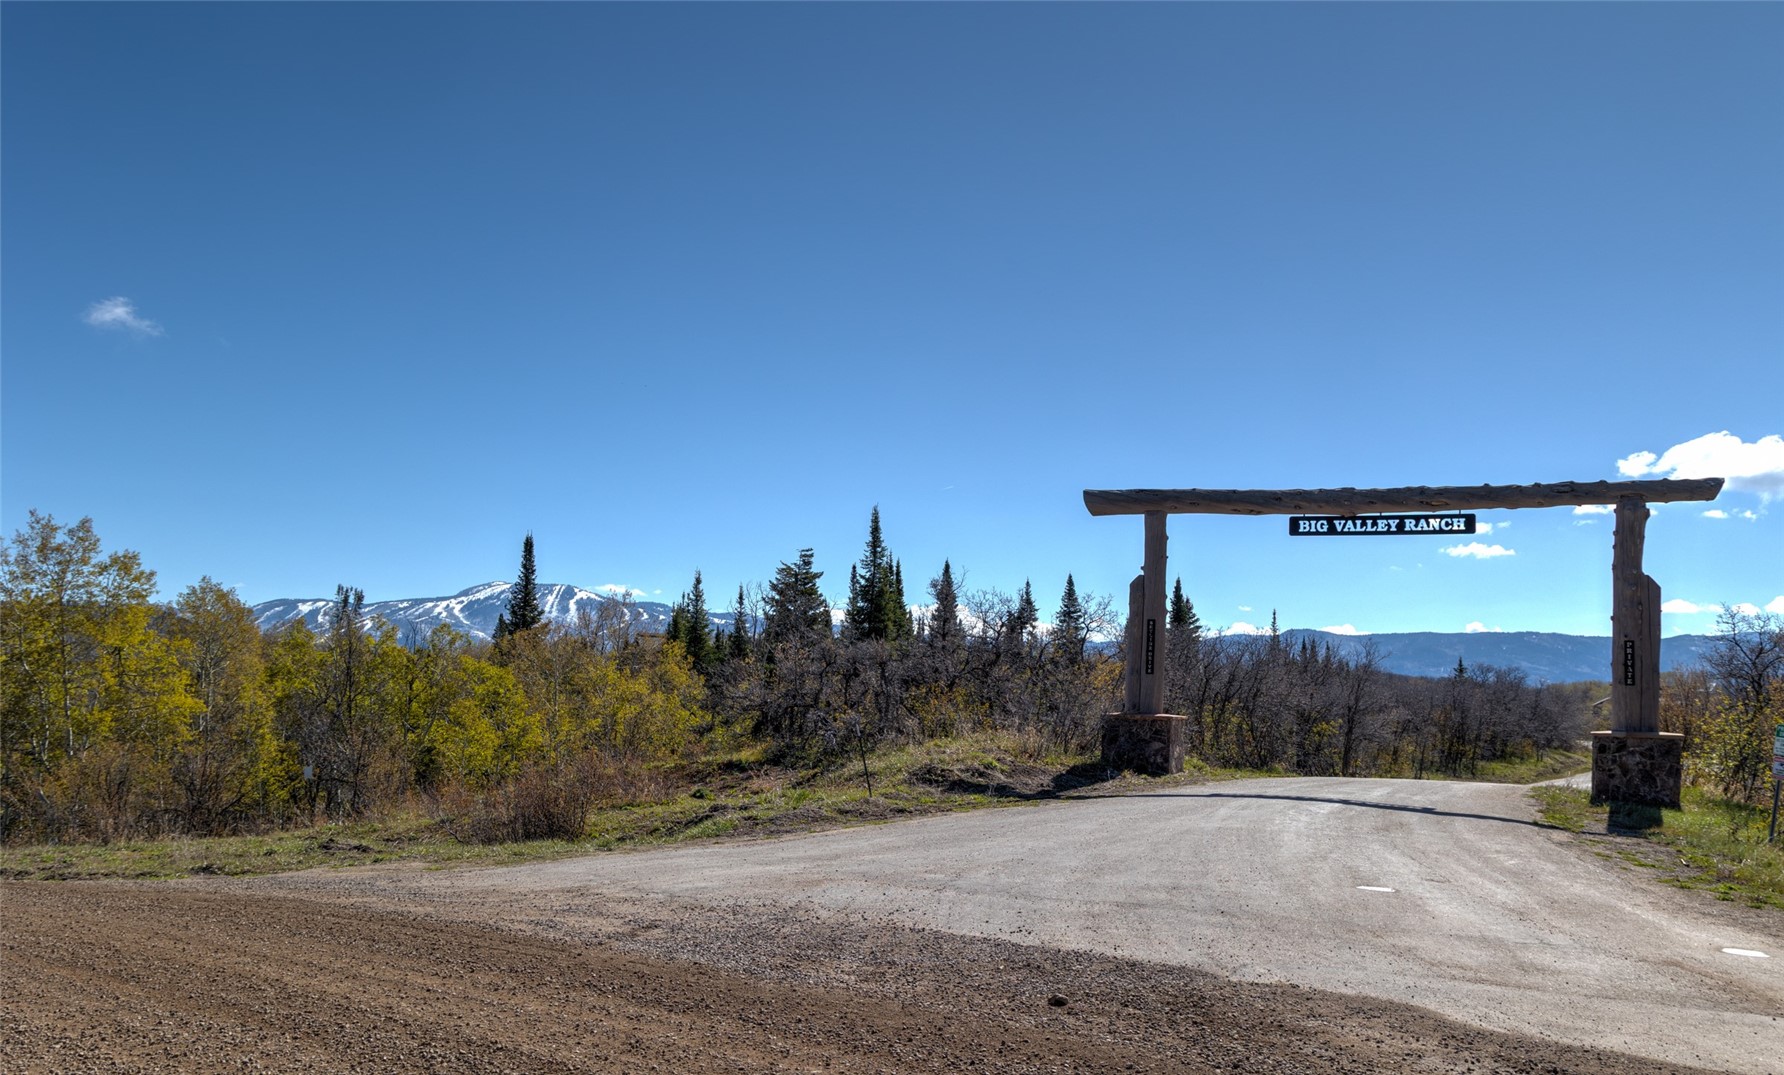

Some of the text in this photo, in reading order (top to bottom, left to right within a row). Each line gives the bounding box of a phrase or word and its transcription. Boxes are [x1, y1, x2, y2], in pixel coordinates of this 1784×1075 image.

[1298, 518, 1466, 532] BIG VALLEY RANCH
